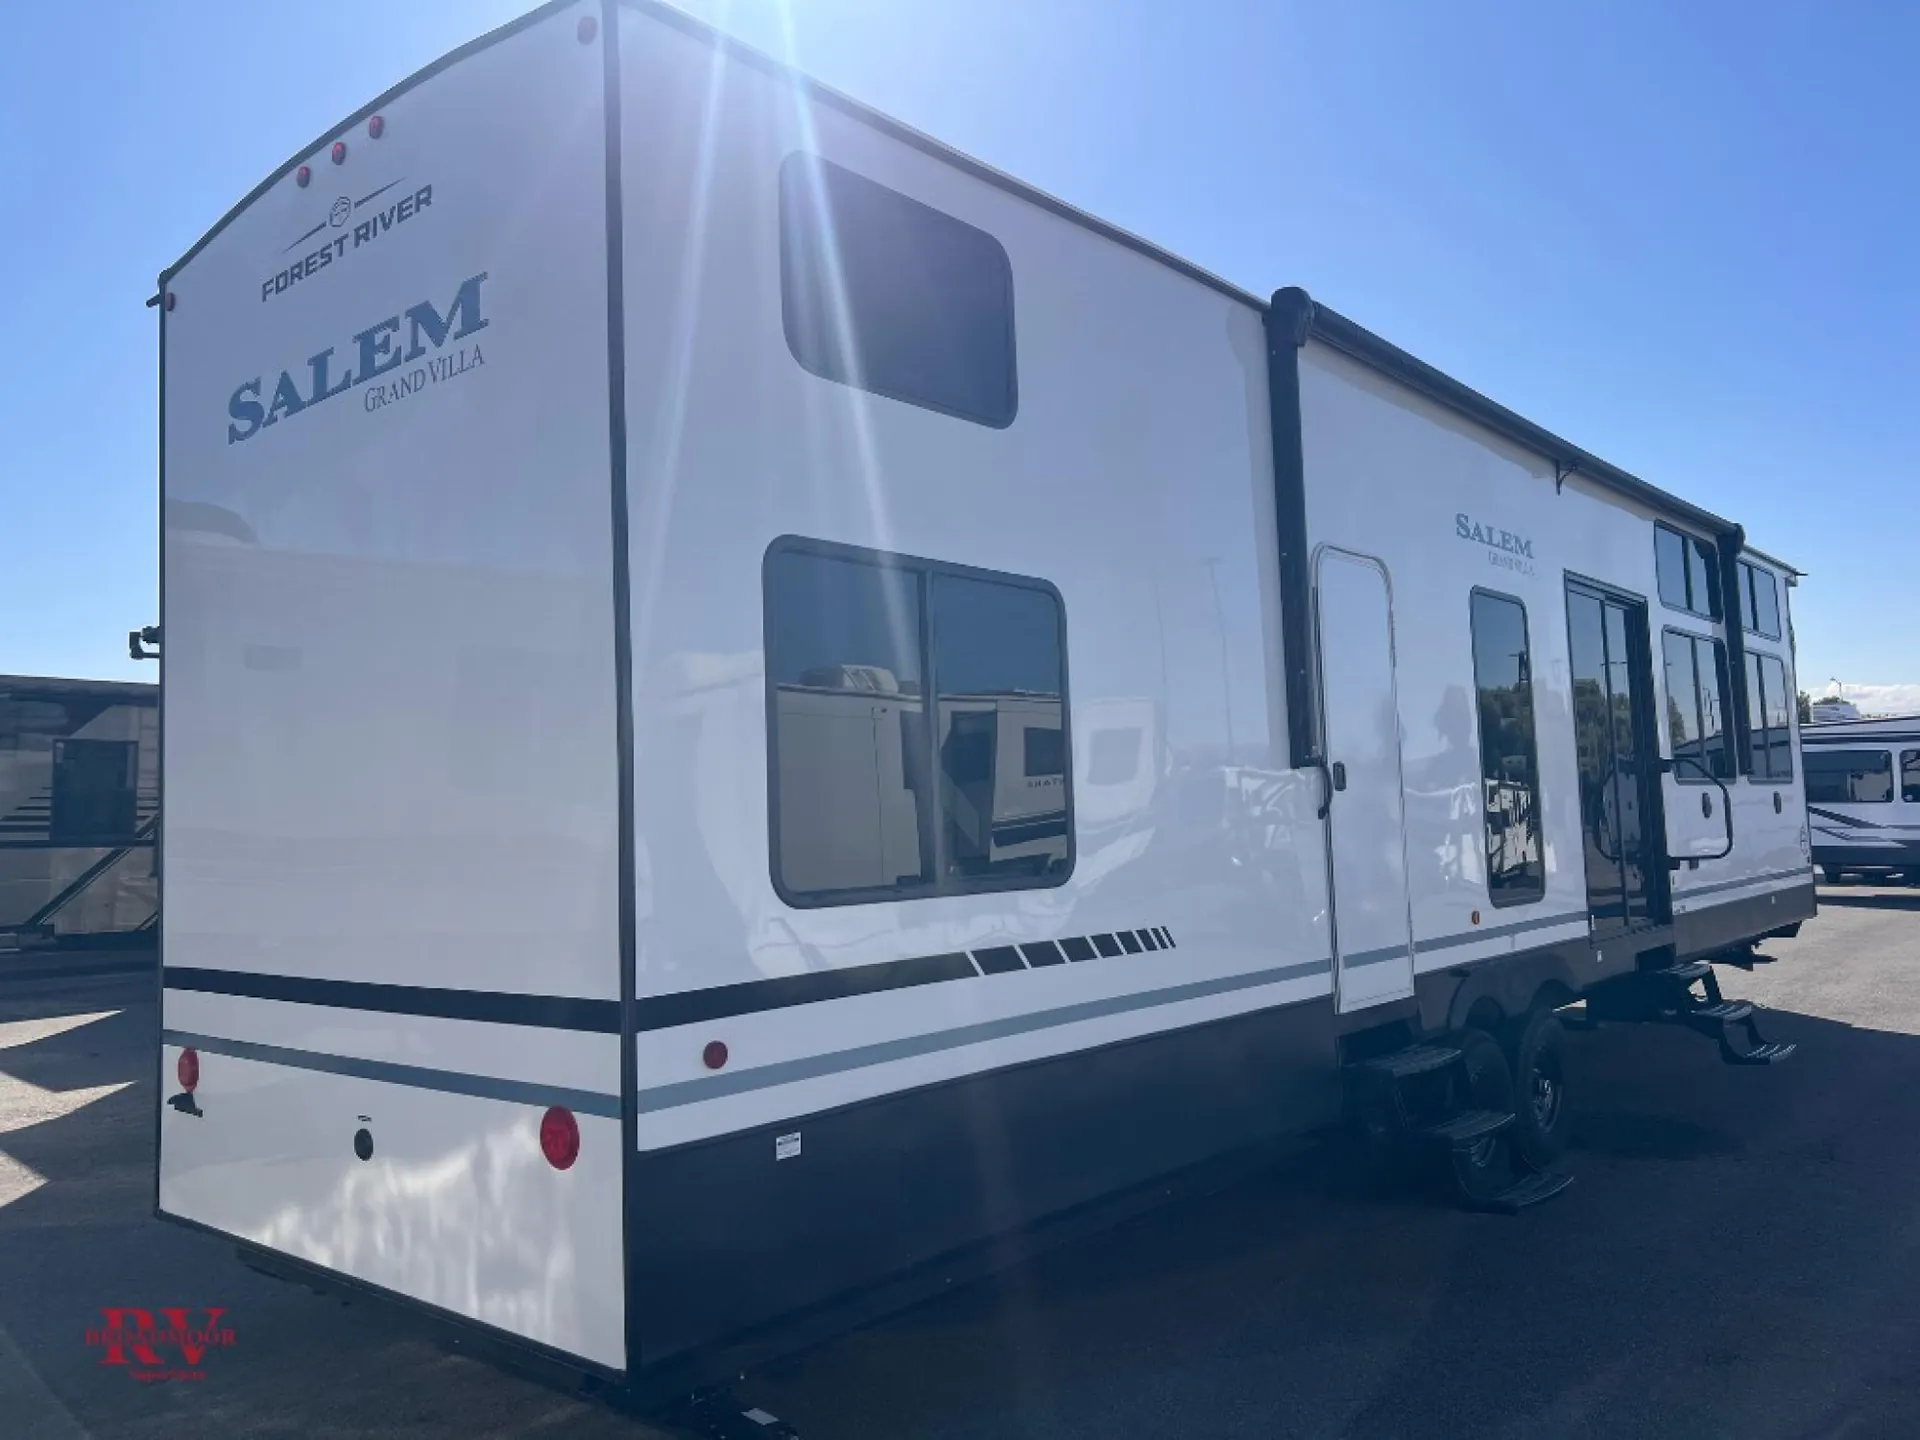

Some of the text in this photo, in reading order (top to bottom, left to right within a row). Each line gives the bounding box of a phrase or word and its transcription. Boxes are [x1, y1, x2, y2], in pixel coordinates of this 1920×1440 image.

[262, 184, 433, 303] FOREST RIVER
[227, 271, 490, 446] SALEM
[364, 344, 486, 413] GRAND VILLA
[1455, 512, 1535, 560] SALEM
